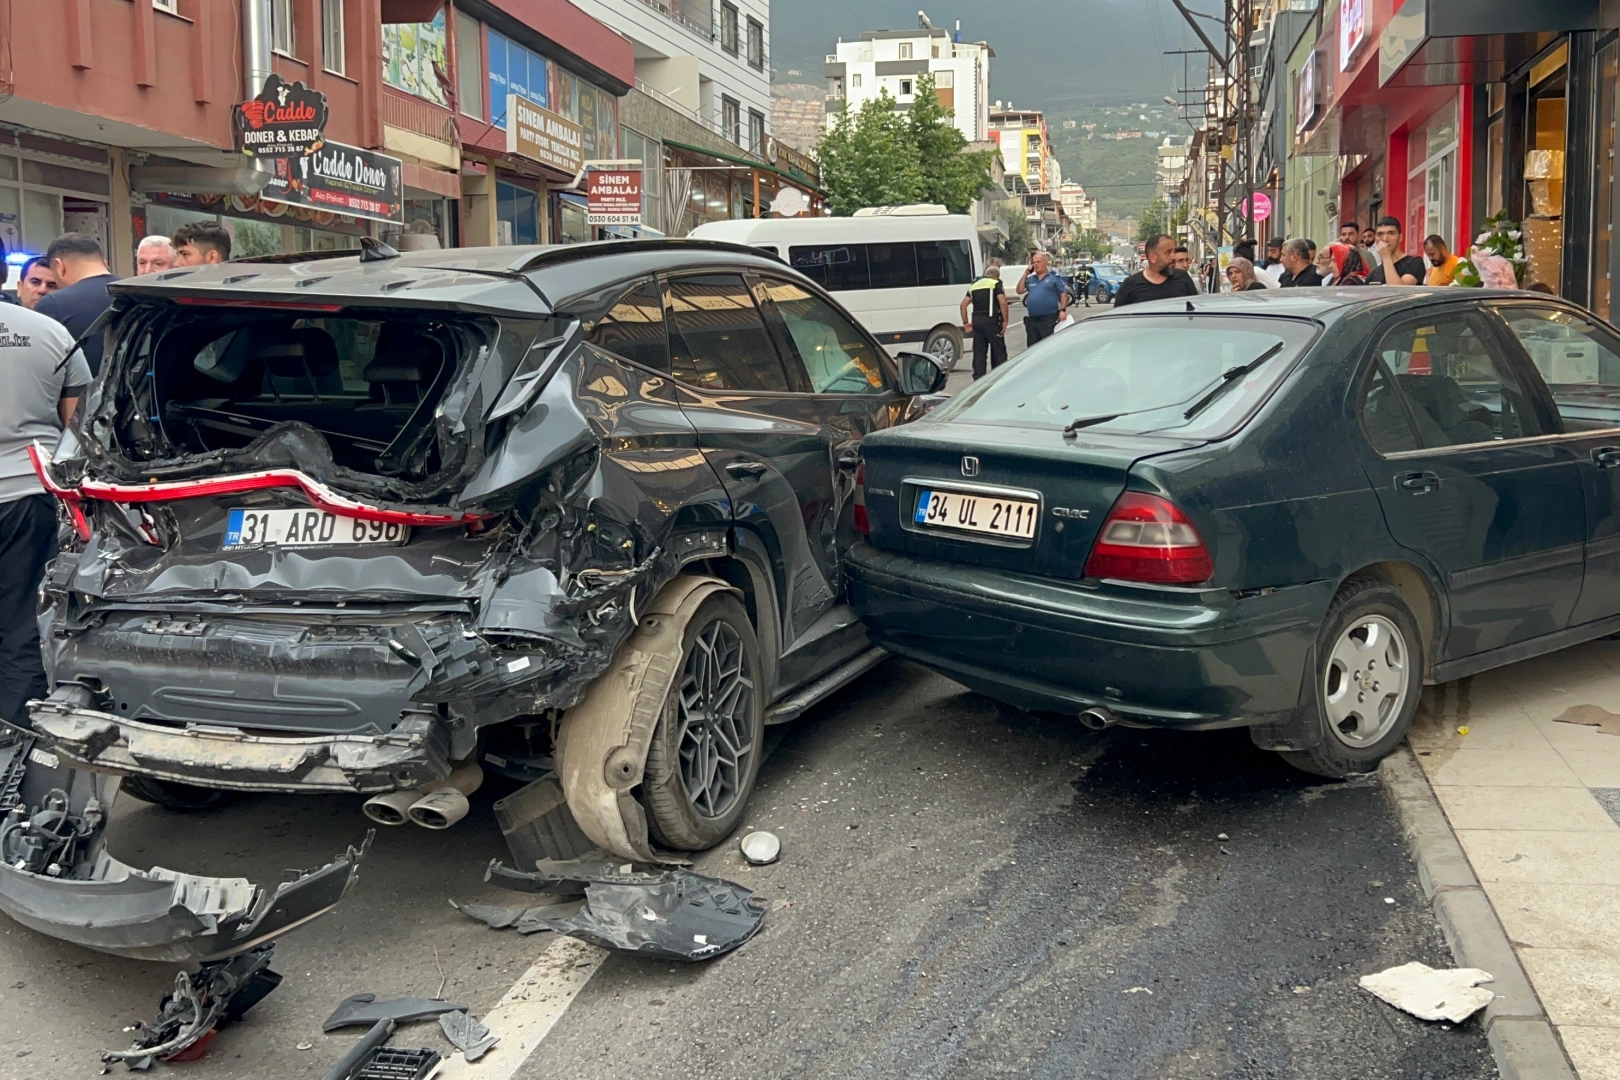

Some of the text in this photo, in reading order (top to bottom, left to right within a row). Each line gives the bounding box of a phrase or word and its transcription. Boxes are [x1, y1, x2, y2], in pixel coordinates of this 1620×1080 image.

[264, 101, 315, 123] Cadde
[276, 130, 287, 142] &
[288, 128, 319, 142] KEBAP
[517, 102, 545, 132] SİNEM
[546, 118, 581, 148] AMBALAJ
[520, 127, 535, 143] PARTY
[535, 133, 549, 149] STORE
[598, 173, 630, 185] SİNEM
[591, 185, 638, 195] AMBALAJ
[315, 191, 326, 200] Alo
[349, 197, 360, 209] 0552
[360, 198, 369, 210] 715
[589, 215, 639, 223] 0530 604 51 94
[918, 495, 1034, 534] TR 34 UL 2111
[228, 531, 239, 541] TR
[242, 513, 269, 543] 31
[285, 512, 336, 543] ARD
